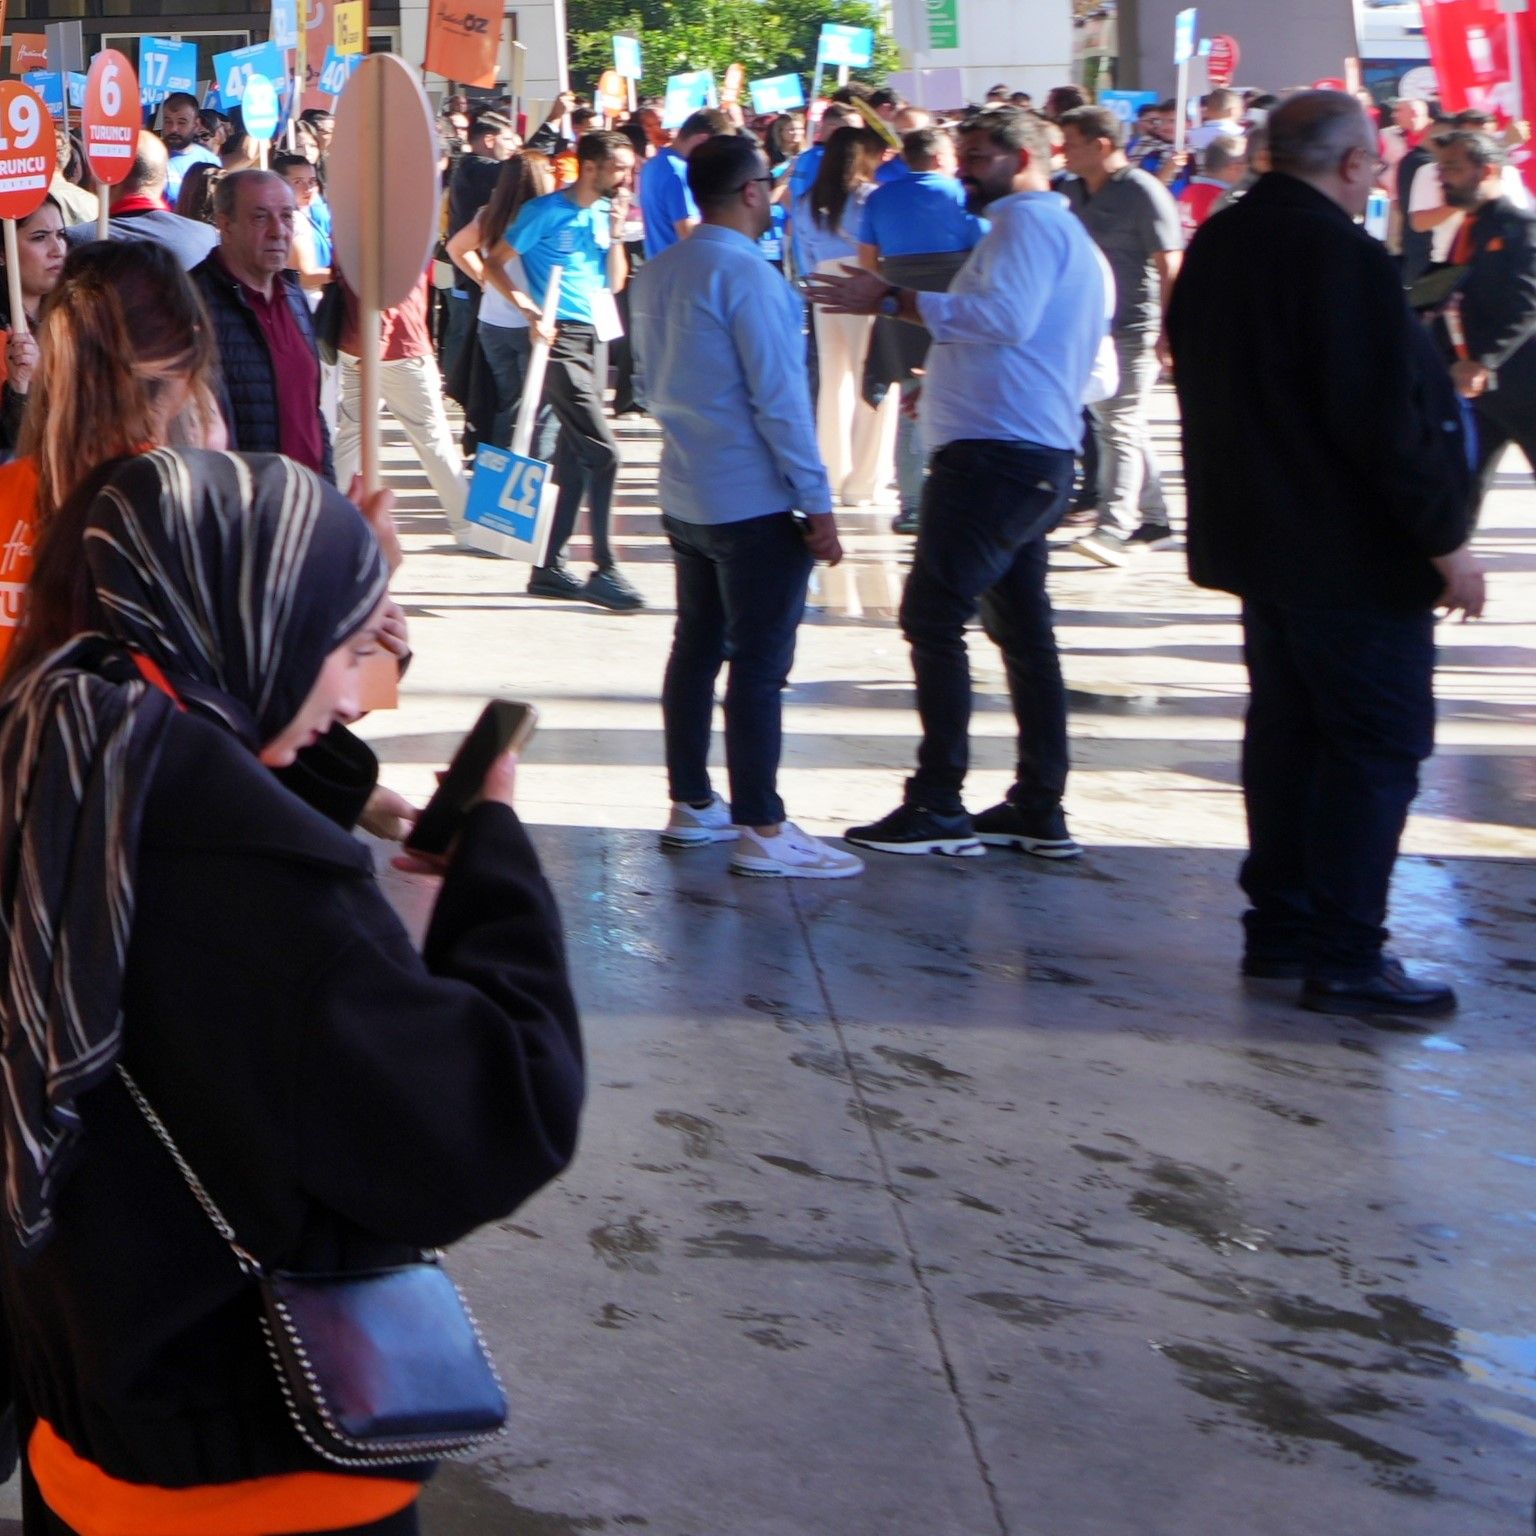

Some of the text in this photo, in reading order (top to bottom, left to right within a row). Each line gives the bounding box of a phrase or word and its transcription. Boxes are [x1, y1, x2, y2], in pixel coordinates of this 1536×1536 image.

[99, 63, 122, 116] 6
[144, 52, 169, 87] 17
[89, 125, 131, 142] TURUNCU
[498, 461, 544, 520] 37
